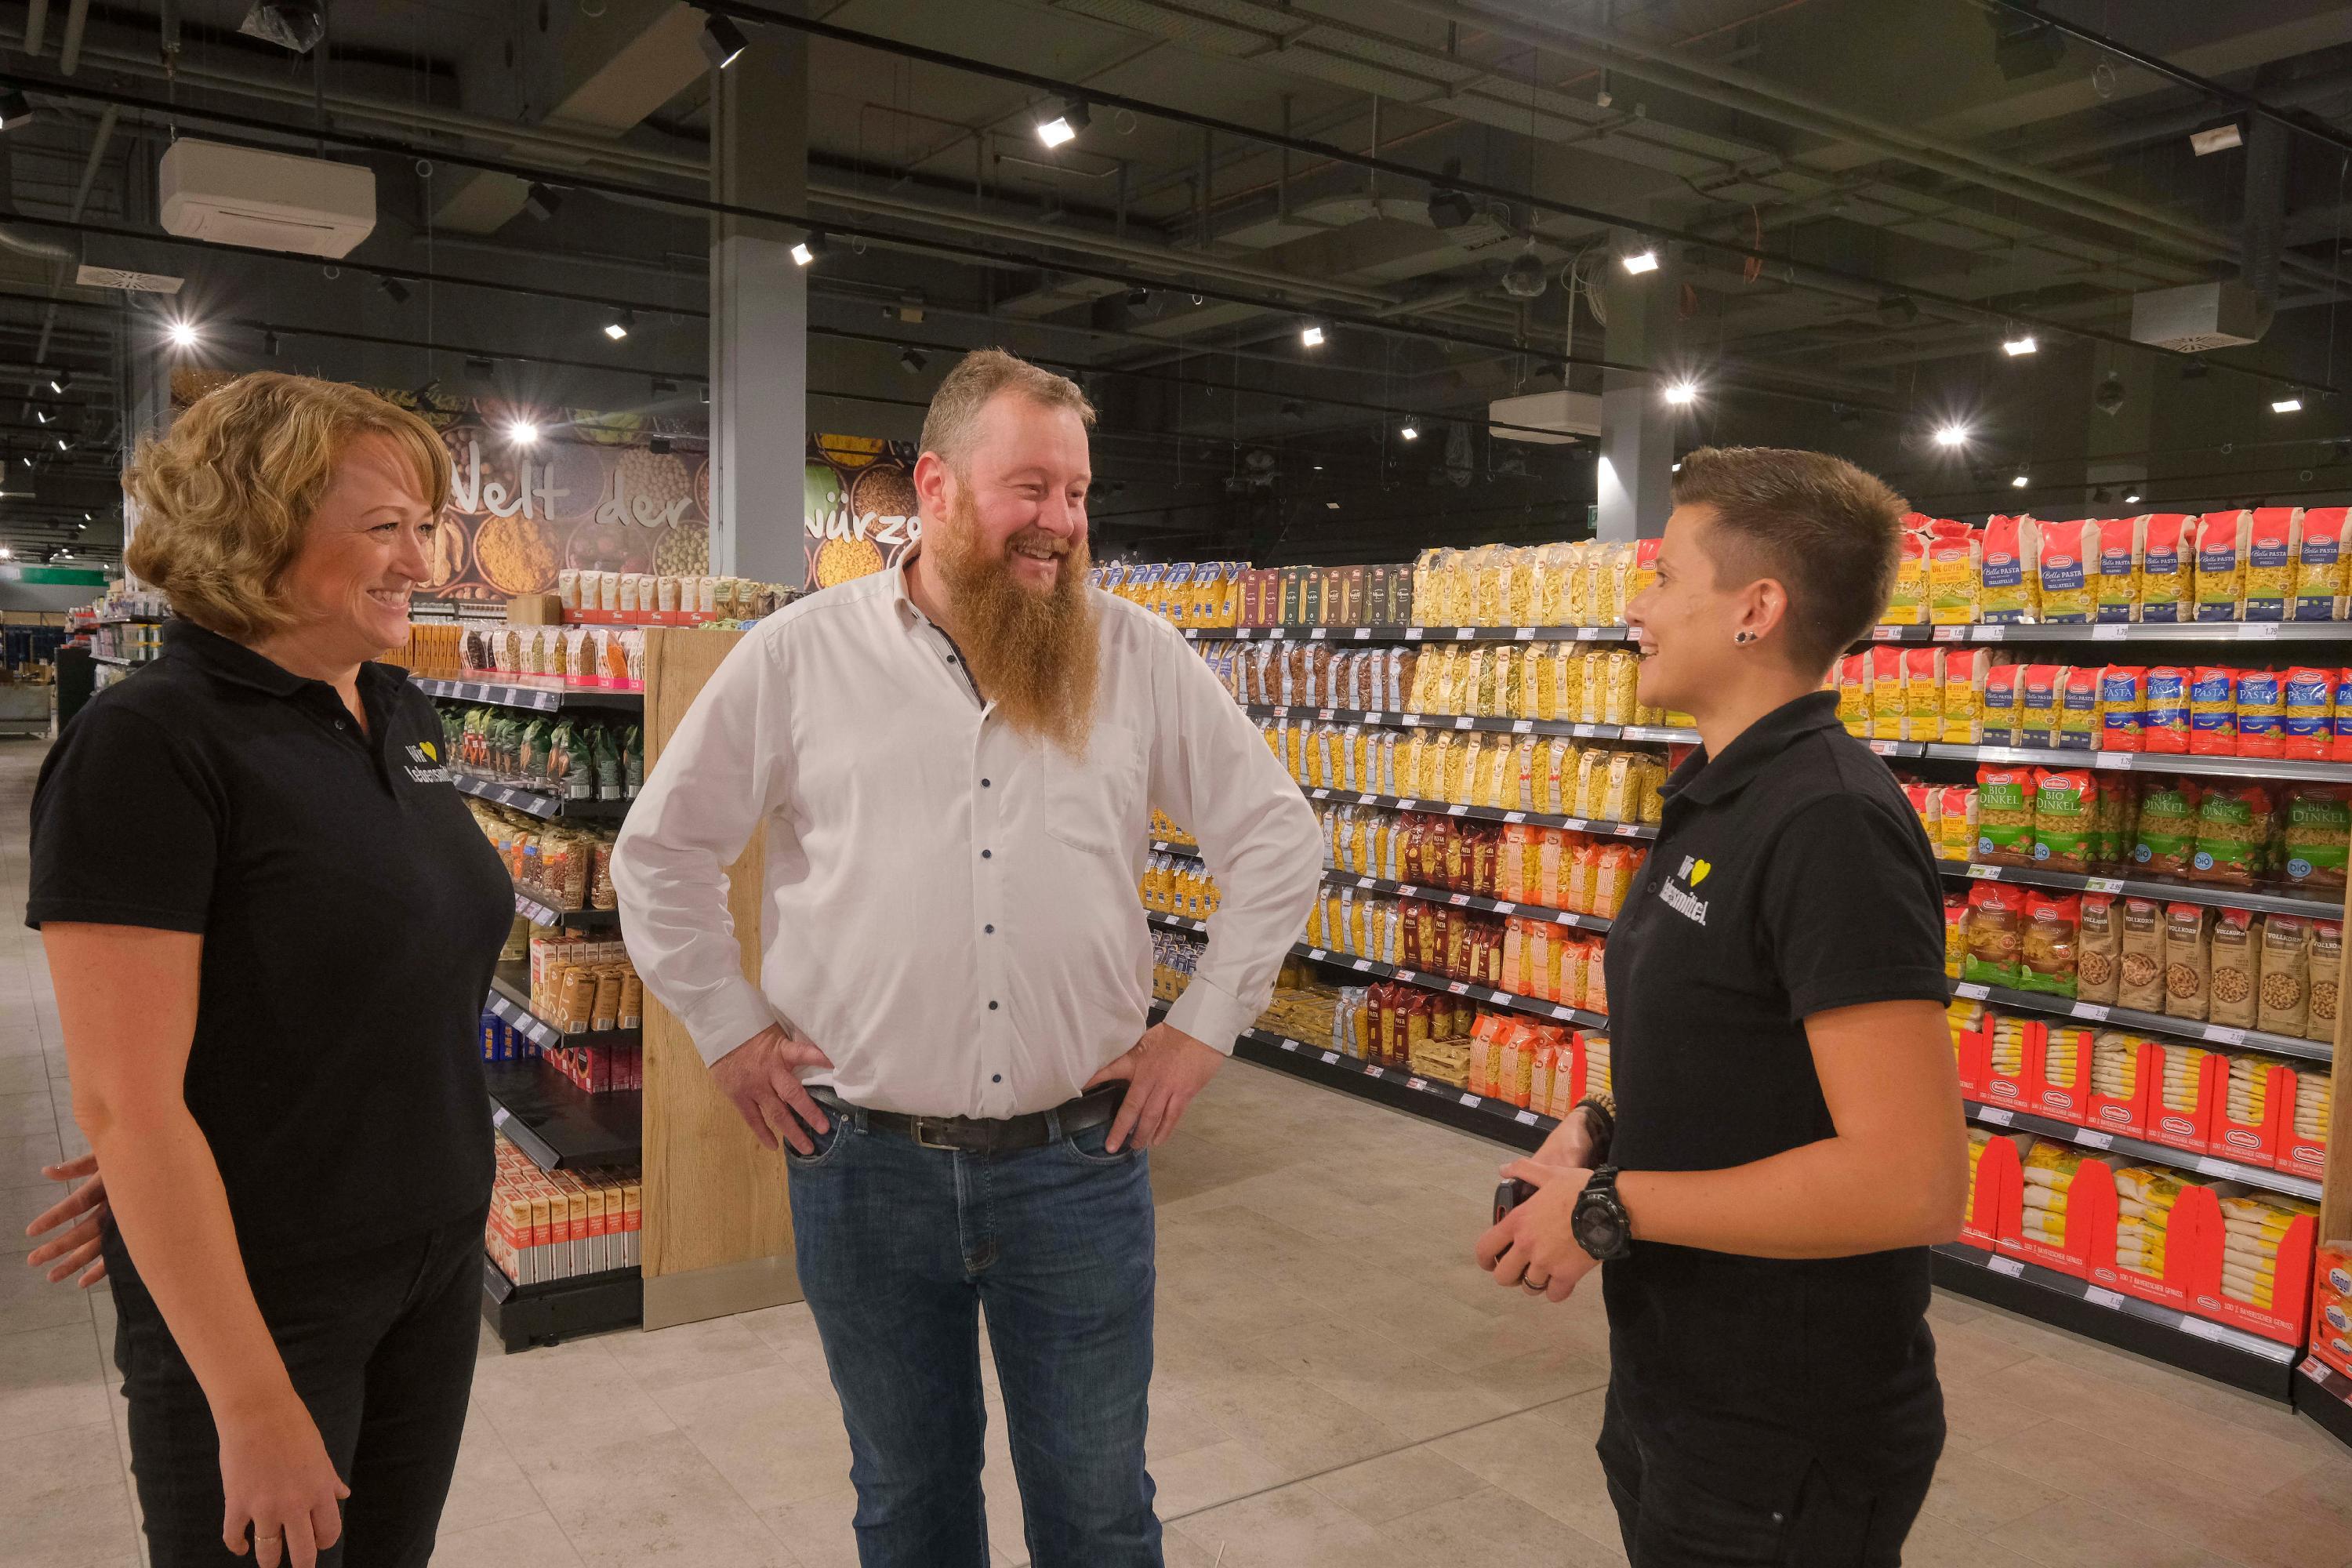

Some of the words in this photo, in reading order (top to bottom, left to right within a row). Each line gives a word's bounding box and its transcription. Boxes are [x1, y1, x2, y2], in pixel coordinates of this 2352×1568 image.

[594, 470, 693, 528] der
[2265, 627, 2278, 636] 1.79
[2104, 688, 2132, 697] PASTA
[2194, 688, 2226, 697] PASTA
[2240, 689, 2274, 699] PASTA
[405, 745, 427, 763] Wir
[1989, 786, 2006, 795] BIO
[1980, 793, 2020, 804] DINKEL
[2046, 792, 2063, 800] BIO
[2037, 797, 2078, 811] DINKEL
[2307, 802, 2330, 812] BIO
[2292, 809, 2347, 823] DINKEL
[2169, 924, 2197, 935] VOLLKORN
[2267, 932, 2303, 942] VOLLKORN
[2096, 1009, 2107, 1018] 2.19
[2224, 1302, 2234, 1311] 100
